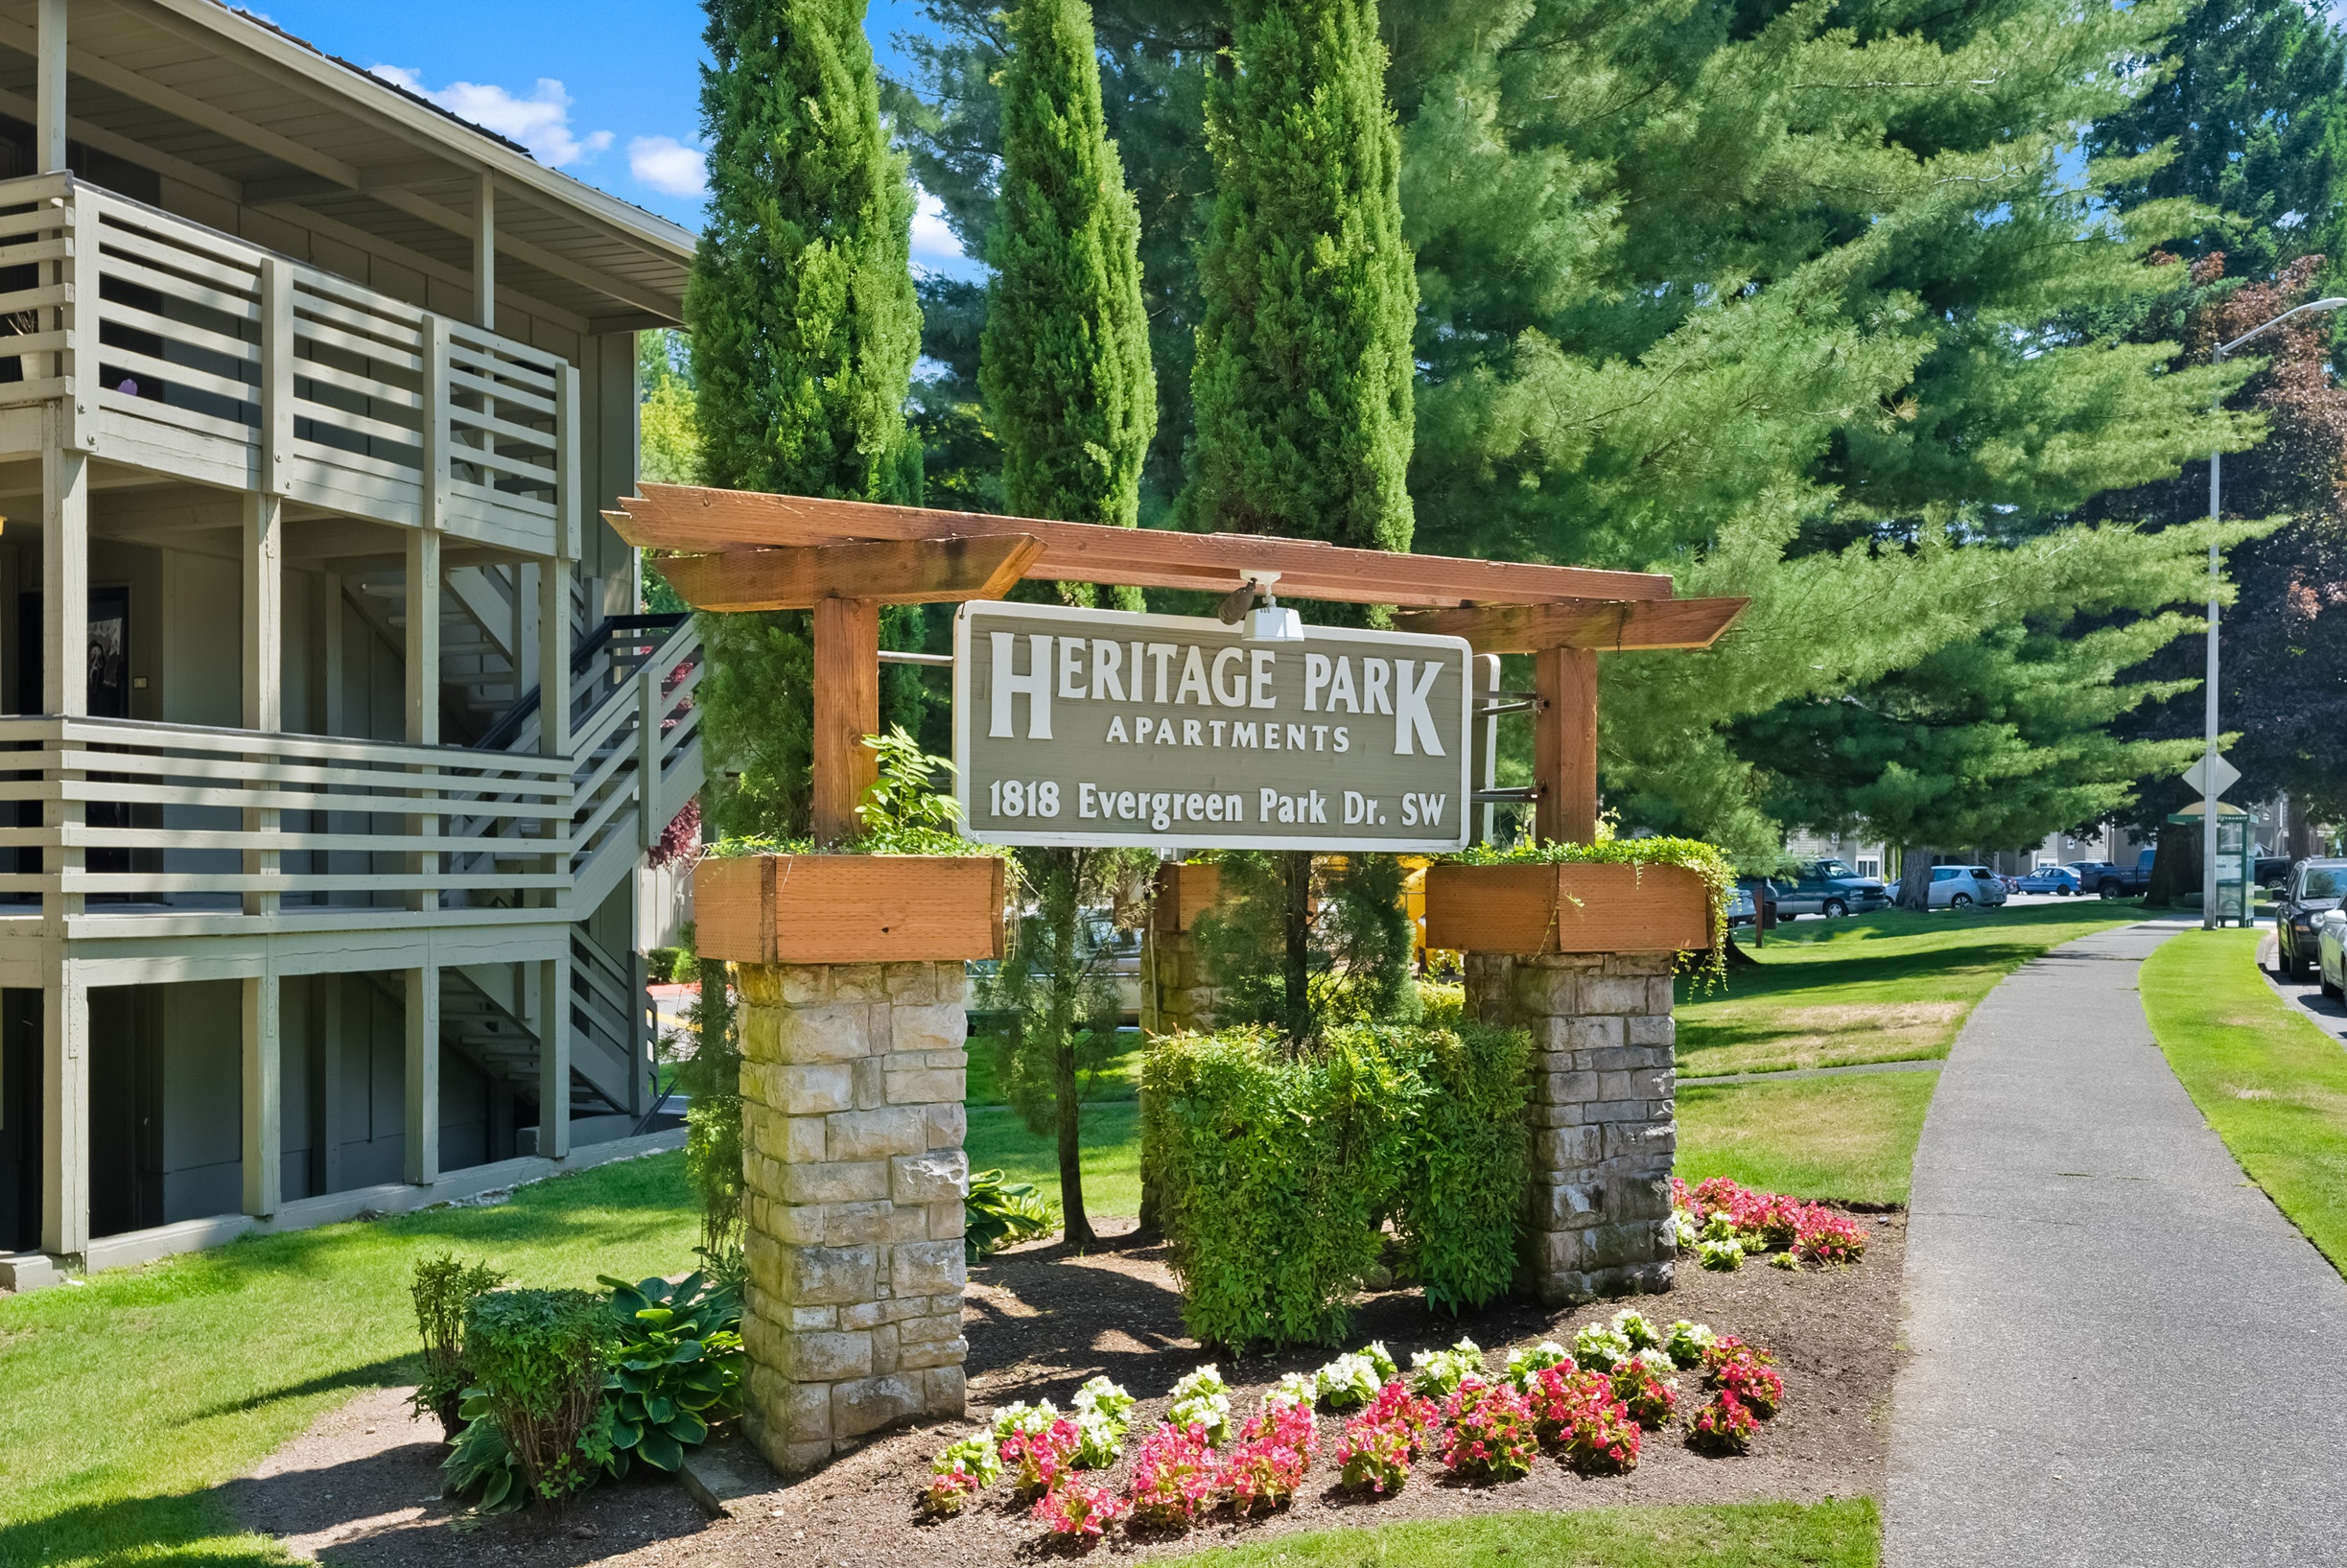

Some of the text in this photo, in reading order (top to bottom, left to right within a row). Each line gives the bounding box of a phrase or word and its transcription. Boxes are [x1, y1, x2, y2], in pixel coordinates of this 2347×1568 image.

[989, 631, 1447, 757] HERITAGE PARK
[1105, 714, 1350, 754] APARTMENTS
[989, 779, 1447, 831] 1818 Evergreen Park Dr. SW
